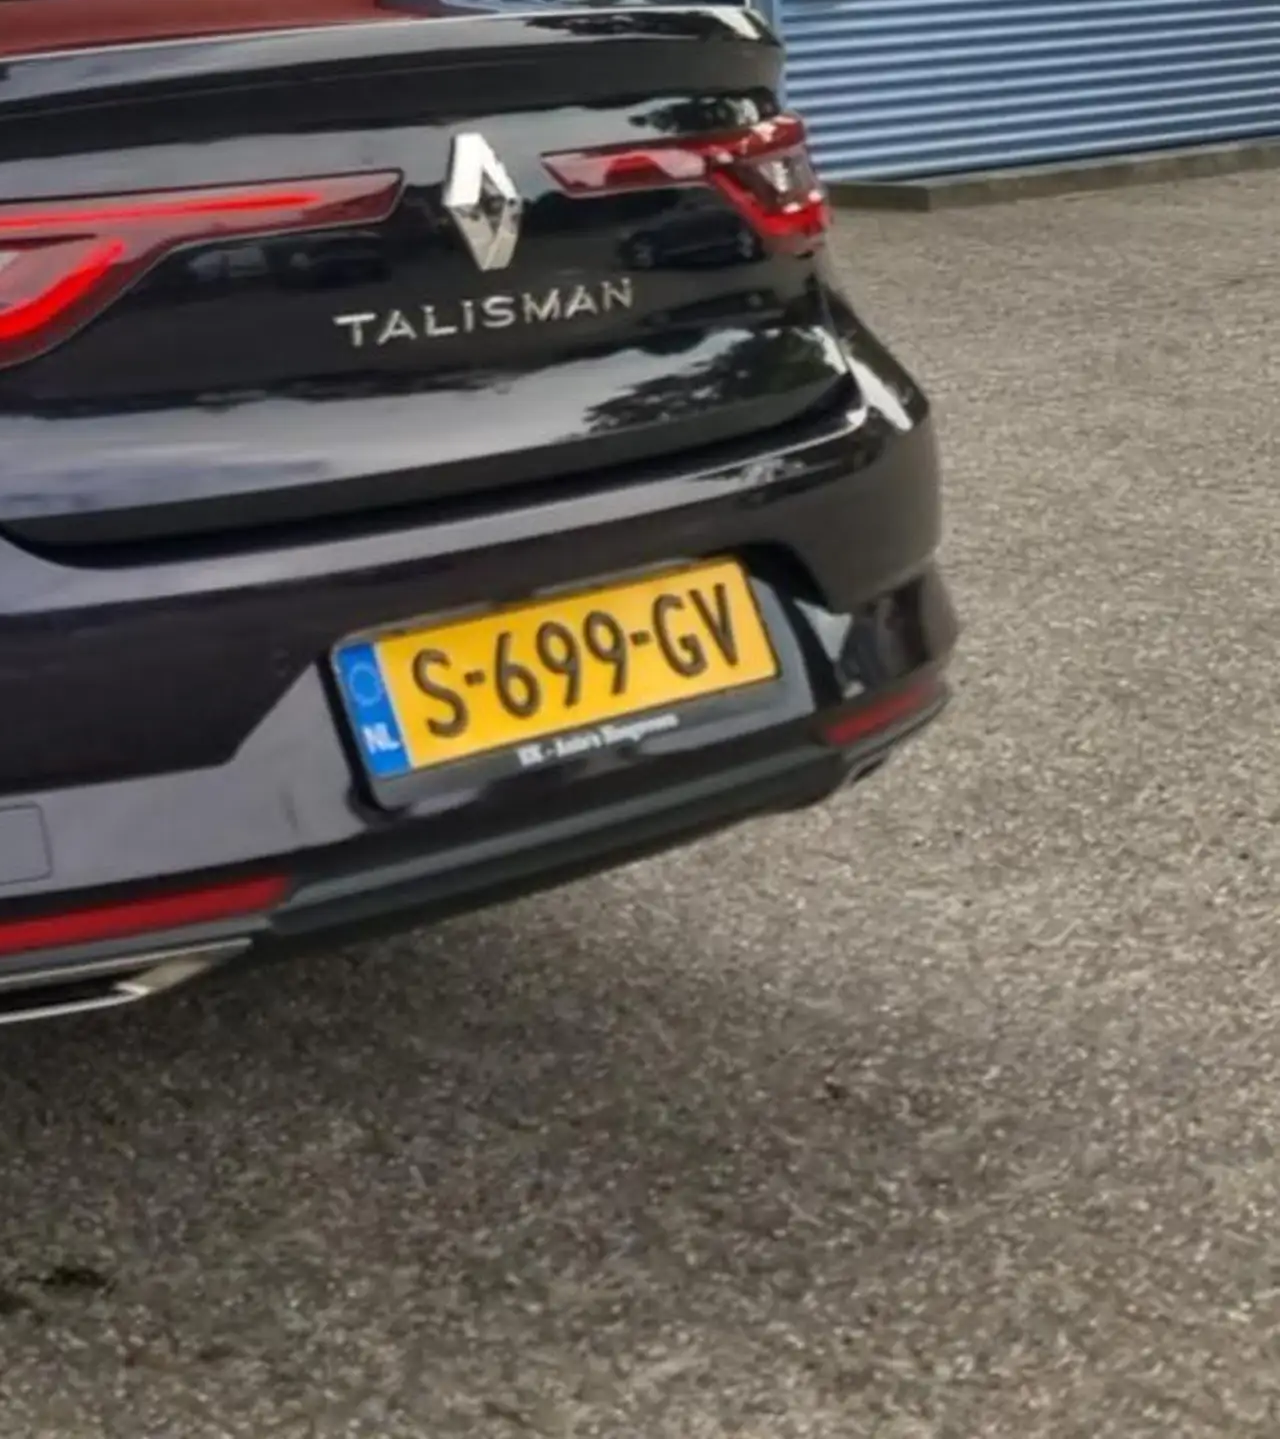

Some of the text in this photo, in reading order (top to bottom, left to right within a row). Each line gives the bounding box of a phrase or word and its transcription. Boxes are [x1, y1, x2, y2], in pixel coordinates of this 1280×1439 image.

[333, 277, 633, 348] TALISMAN
[412, 583, 741, 739] S-699-GV
[362, 720, 402, 756] NL
